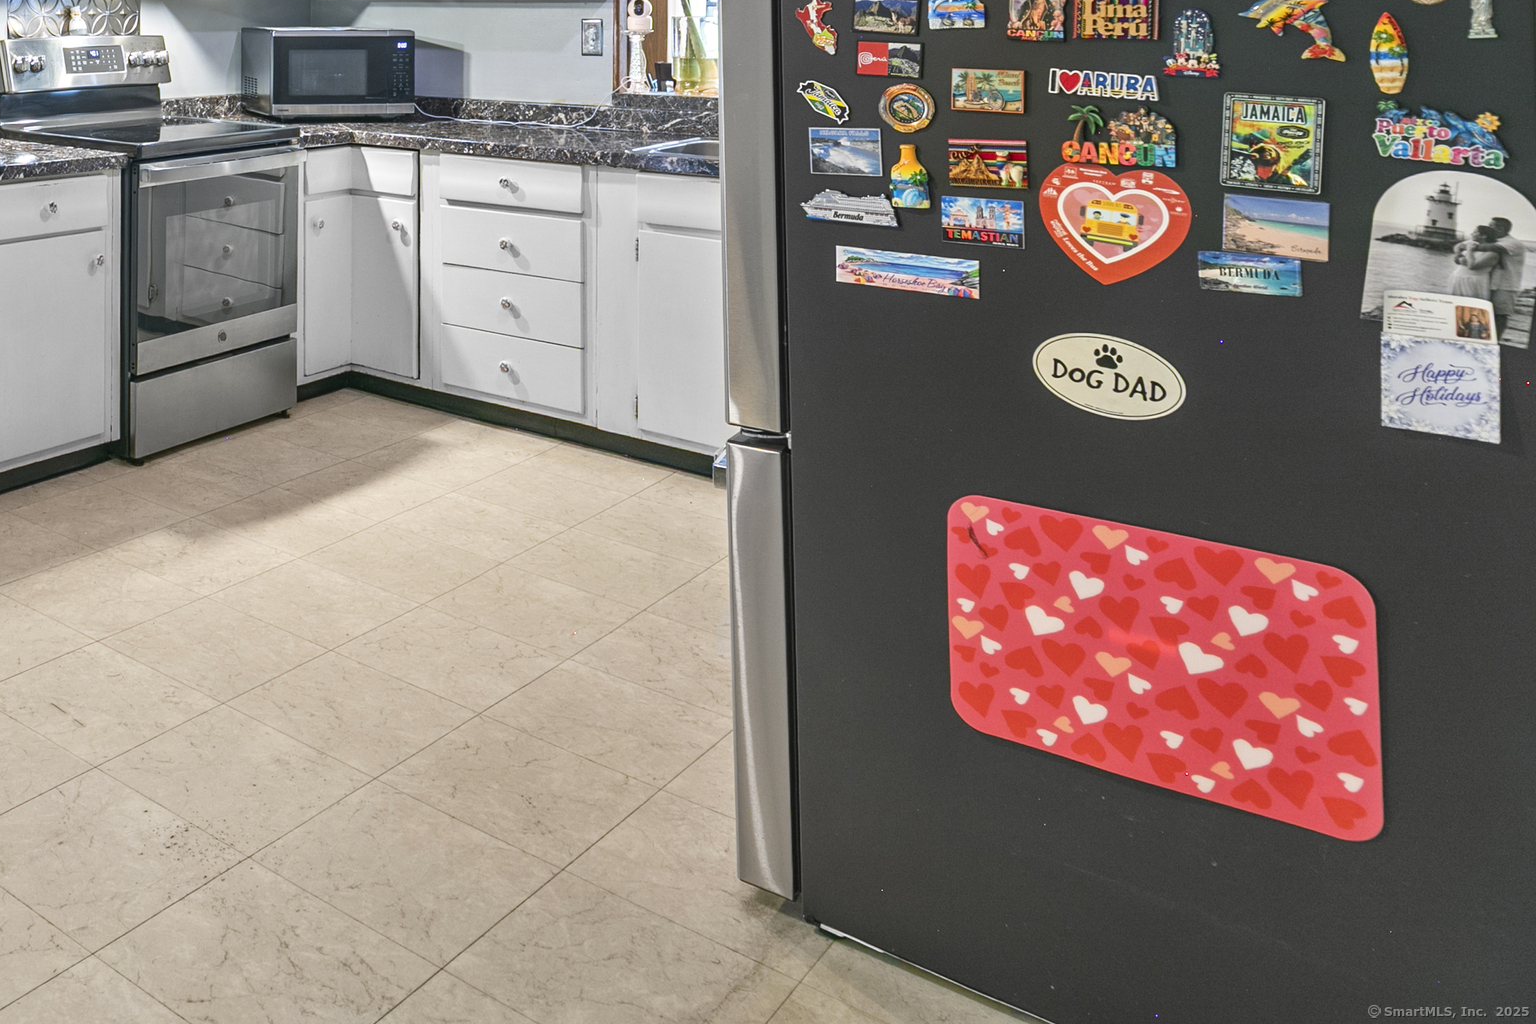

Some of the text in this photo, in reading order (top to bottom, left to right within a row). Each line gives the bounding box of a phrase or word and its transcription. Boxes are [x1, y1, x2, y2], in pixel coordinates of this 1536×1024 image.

[1084, 0, 1148, 19] Lima
[1007, 29, 1064, 39] CANCUN
[1084, 16, 1148, 37] Perú
[1080, 72, 1158, 100] ARUBA
[805, 86, 841, 116] Jamaica
[1243, 102, 1305, 123] JAMAICA
[1376, 118, 1451, 140] Puerto
[1061, 140, 1176, 168] CANCUN
[1373, 133, 1504, 169] Vallarta
[832, 210, 864, 221] Bermuda
[946, 229, 1018, 243] TEMASTIAN
[883, 273, 926, 287] Horseshoe
[927, 278, 946, 293] Bay
[1219, 266, 1280, 281] BERMUDA
[1051, 358, 1167, 402] DOG DAD
[1397, 363, 1477, 384] Happy
[1395, 387, 1488, 407] Holidays
